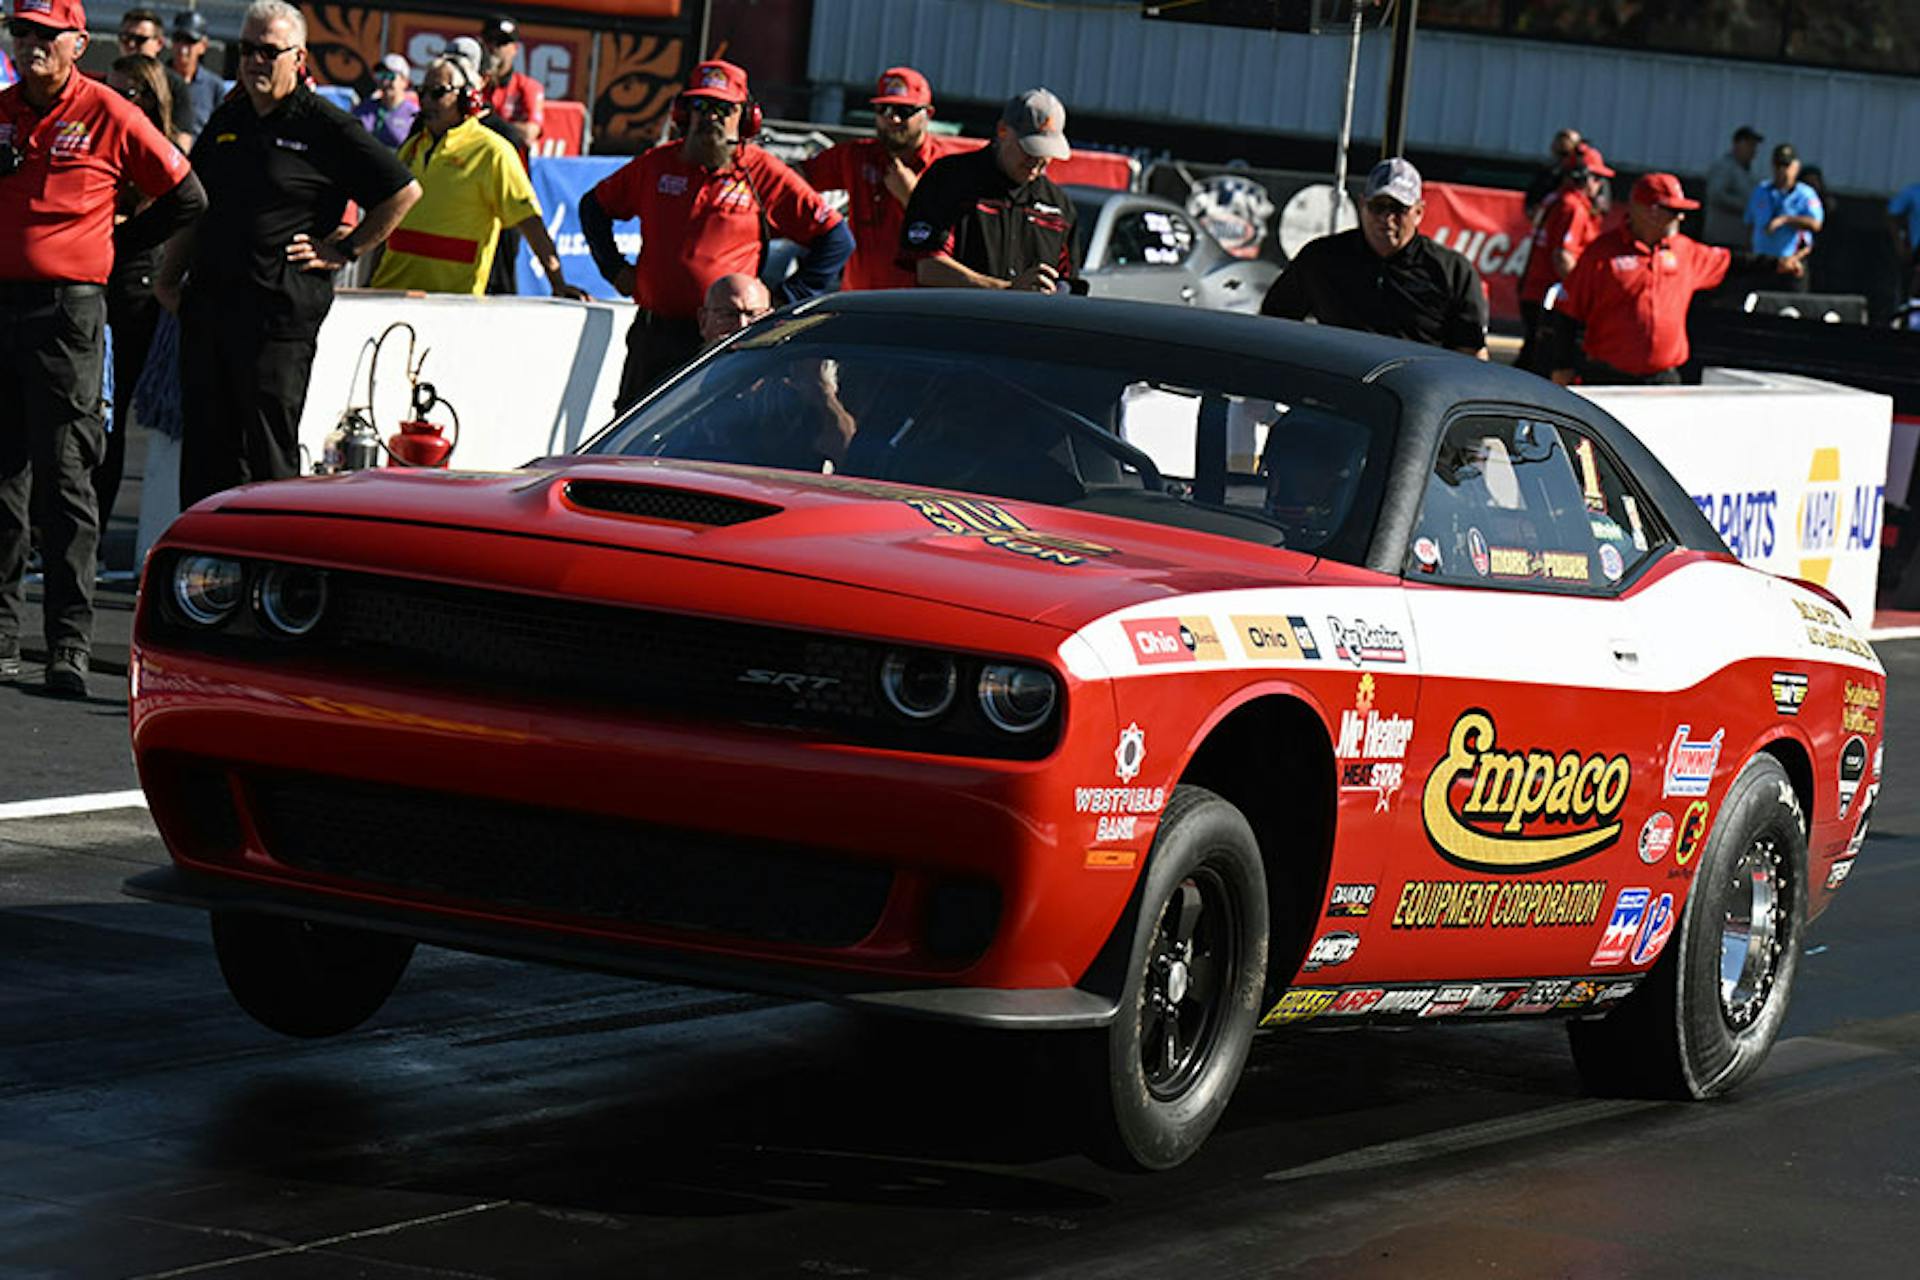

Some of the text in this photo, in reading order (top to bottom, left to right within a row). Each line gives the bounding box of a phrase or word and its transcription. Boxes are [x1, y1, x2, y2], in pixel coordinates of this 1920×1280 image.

[1136, 630, 1178, 654] Ohio
[1249, 627, 1288, 648] Ohio
[737, 668, 840, 692] SRT
[1075, 787, 1164, 813] WESTFIELD
[1422, 708, 1631, 874] Empaco
[1096, 816, 1137, 841] BANK
[1392, 880, 1499, 929] EQUIPMENT
[1491, 879, 1607, 927] CORPORATION
